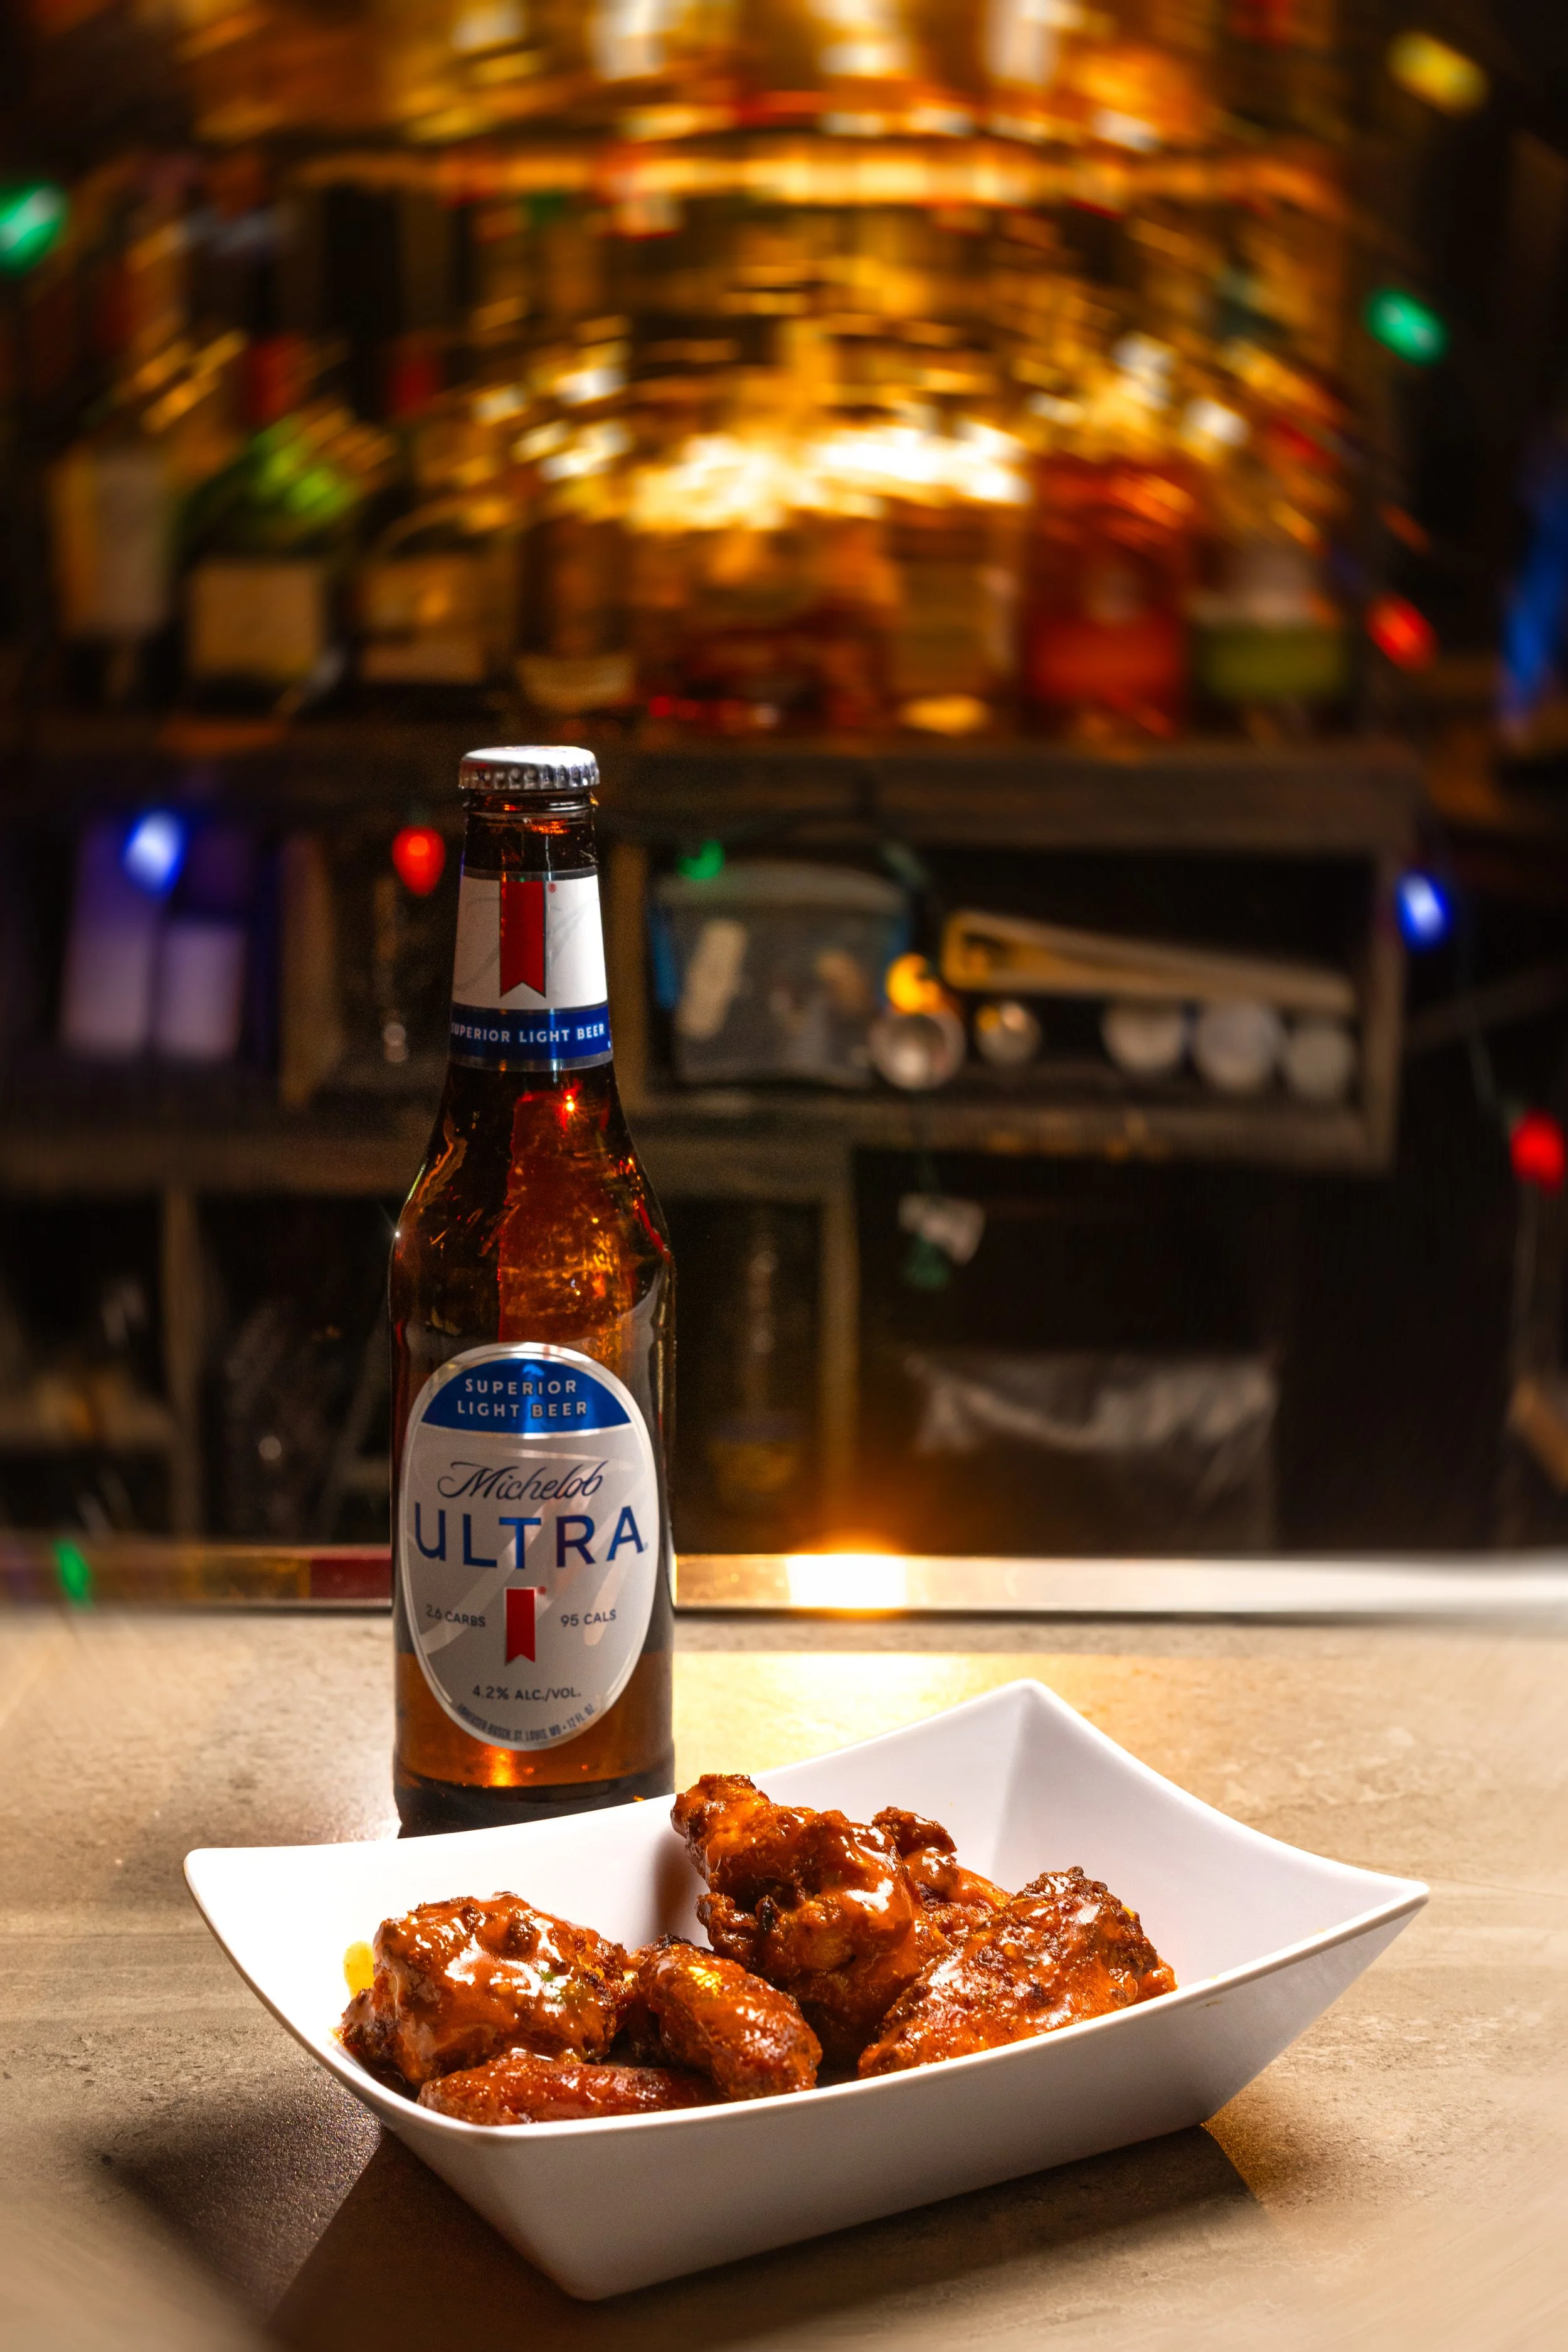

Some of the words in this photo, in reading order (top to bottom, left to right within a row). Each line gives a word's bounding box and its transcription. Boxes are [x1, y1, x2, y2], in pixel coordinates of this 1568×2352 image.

[519, 1030, 569, 1043] LIGHT
[576, 1023, 605, 1040] BEER
[465, 1378, 576, 1396] SUPERIOR
[457, 1400, 519, 1417] LIGHT
[532, 1401, 587, 1417] BEER
[437, 1460, 609, 1500] Michelob
[415, 1502, 644, 1569] ULTRA
[445, 1611, 486, 1628] CARBS
[561, 1613, 580, 1628] 95
[583, 1609, 617, 1625] CALS
